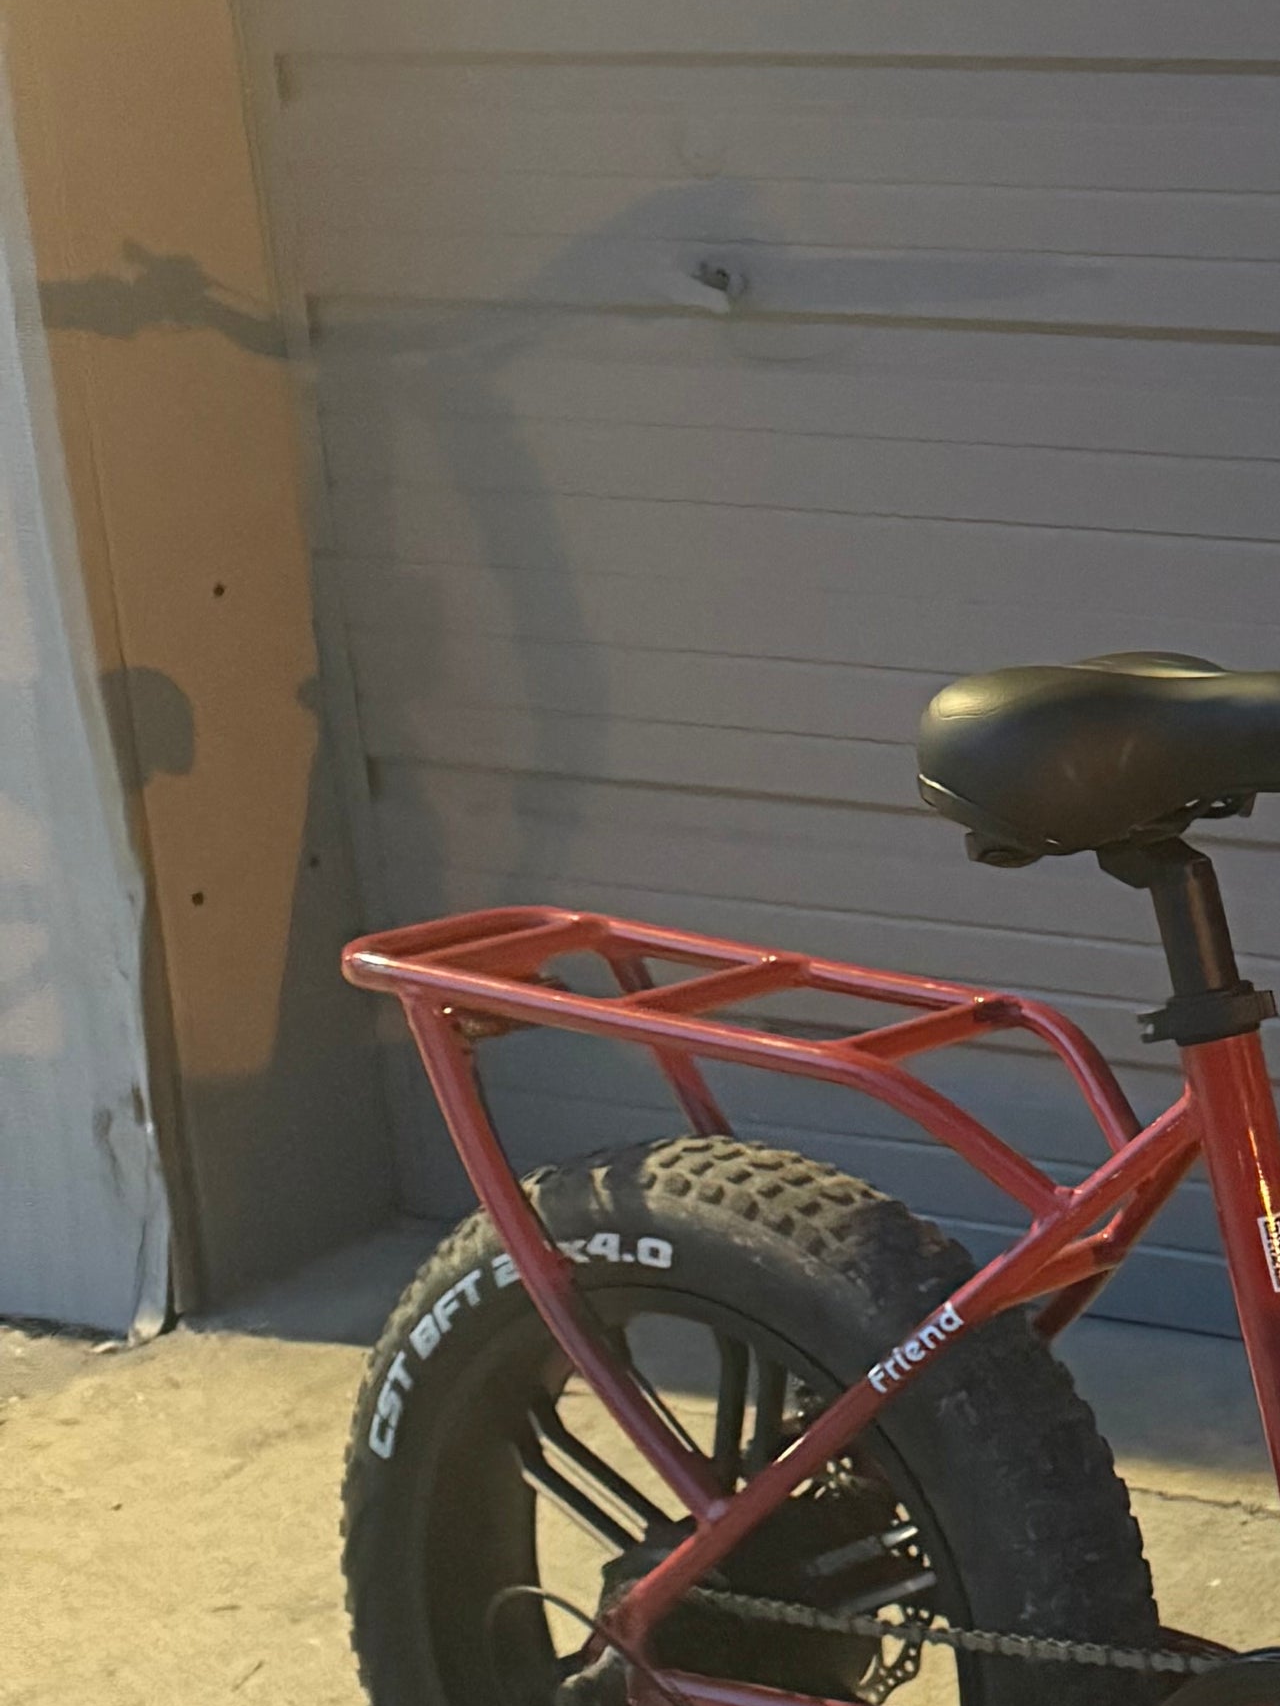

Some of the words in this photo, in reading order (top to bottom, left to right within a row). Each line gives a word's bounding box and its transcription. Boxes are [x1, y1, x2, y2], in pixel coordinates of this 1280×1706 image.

[369, 1350, 413, 1460] CST
[409, 1268, 482, 1361] BFT
[491, 1232, 673, 1288] 2x4.0
[867, 1300, 965, 1394] Friend
